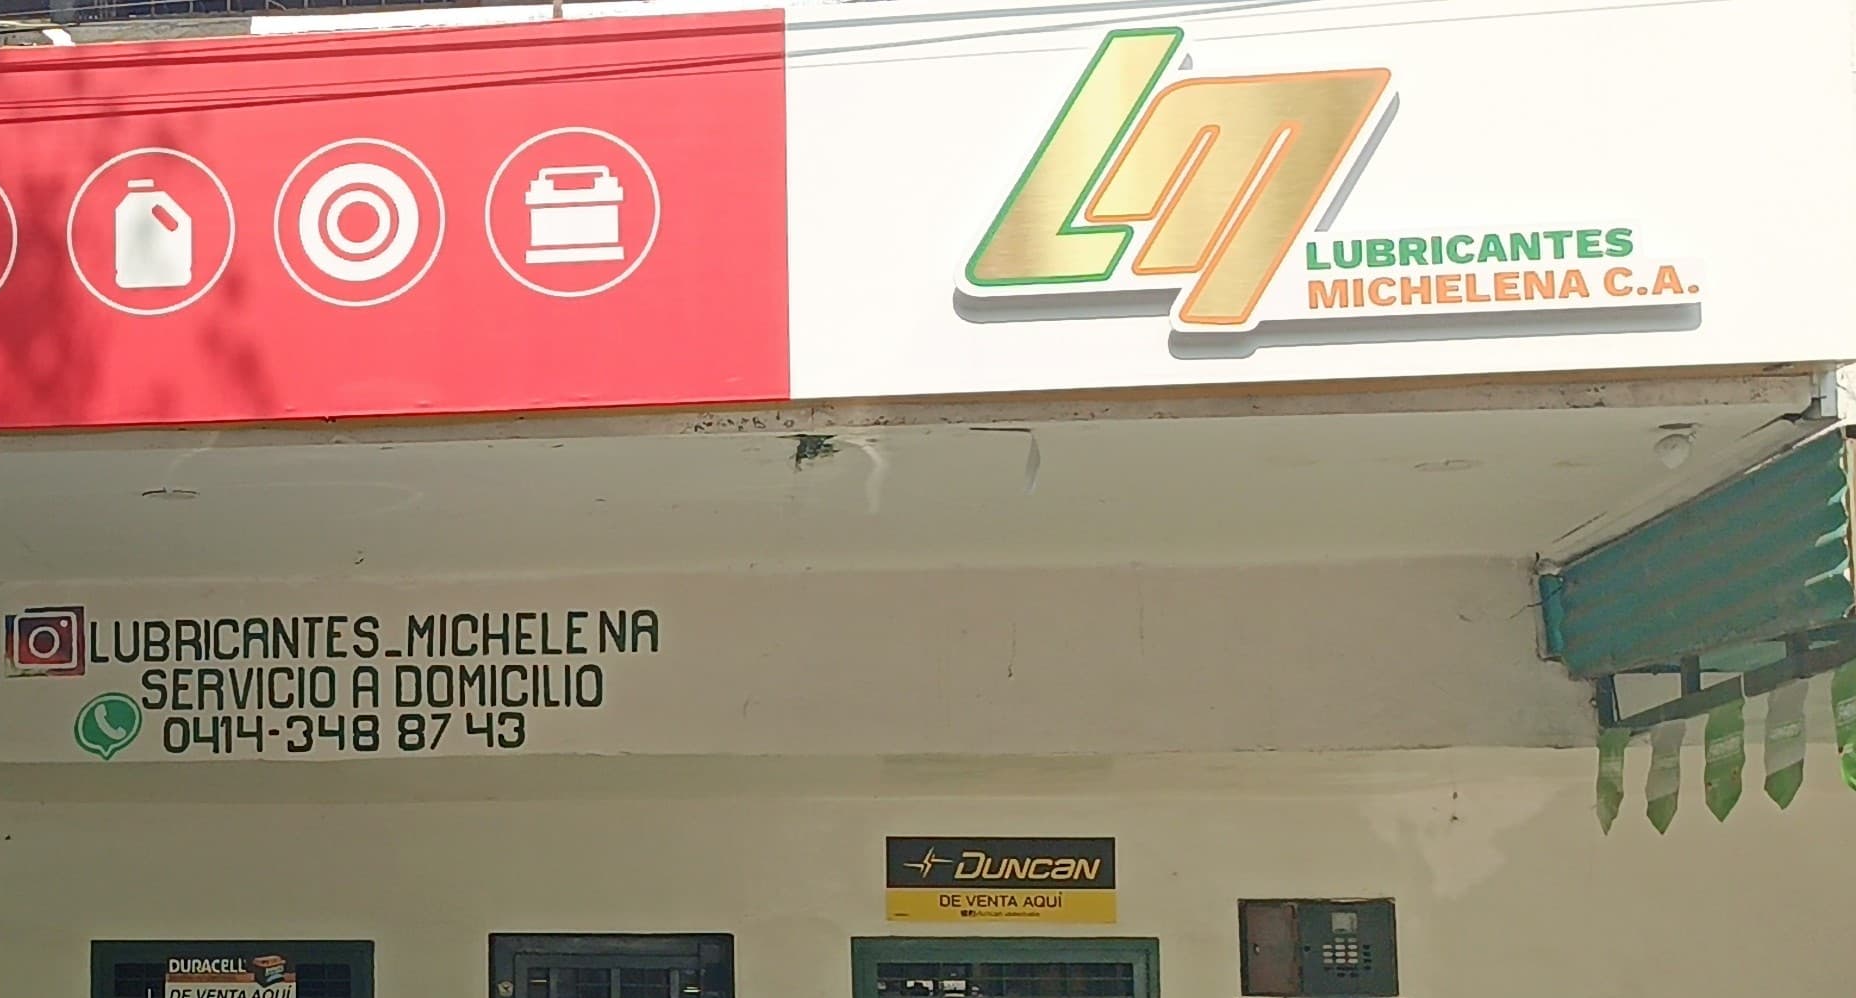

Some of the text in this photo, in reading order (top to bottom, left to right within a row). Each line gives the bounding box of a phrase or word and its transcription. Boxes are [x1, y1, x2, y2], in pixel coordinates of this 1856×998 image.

[1305, 227, 1635, 271] LUBRICANTES
[1307, 264, 1701, 310] MICHELENA C.A.
[141, 664, 604, 710] SERVICIO A DOMICILIO
[162, 711, 527, 755] 0414-348 87 43
[939, 891, 1063, 908] DE VENTA AQUÍ
[168, 957, 246, 974] DURACELL
